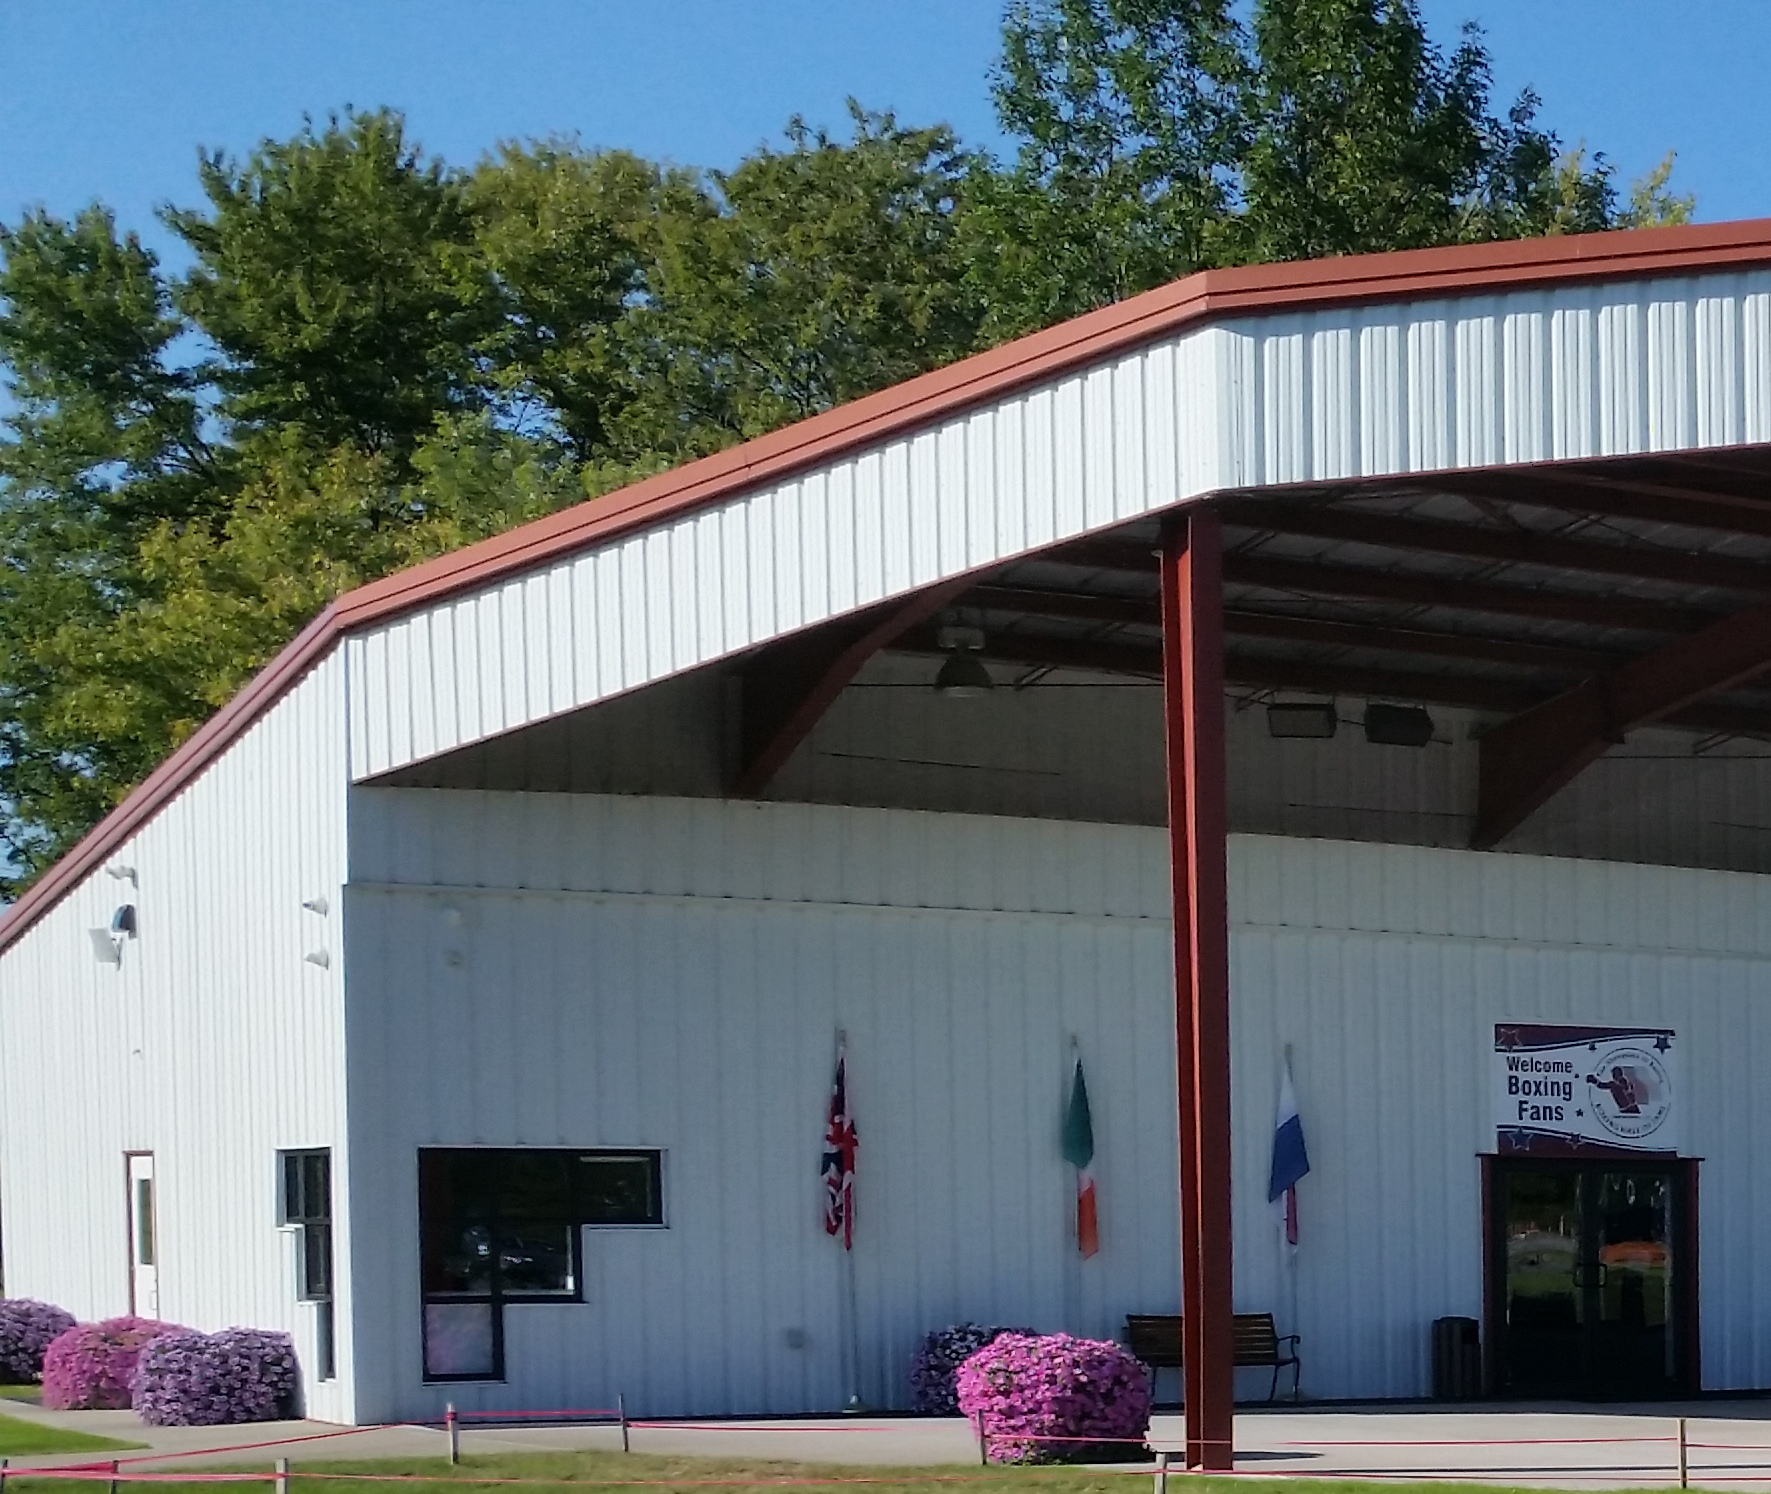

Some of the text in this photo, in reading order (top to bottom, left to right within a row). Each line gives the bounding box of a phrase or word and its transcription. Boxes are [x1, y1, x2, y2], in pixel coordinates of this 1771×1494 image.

[1507, 1056, 1573, 1073] Welcome
[1508, 1076, 1572, 1101] Boxing
[1518, 1101, 1564, 1121] Fans
